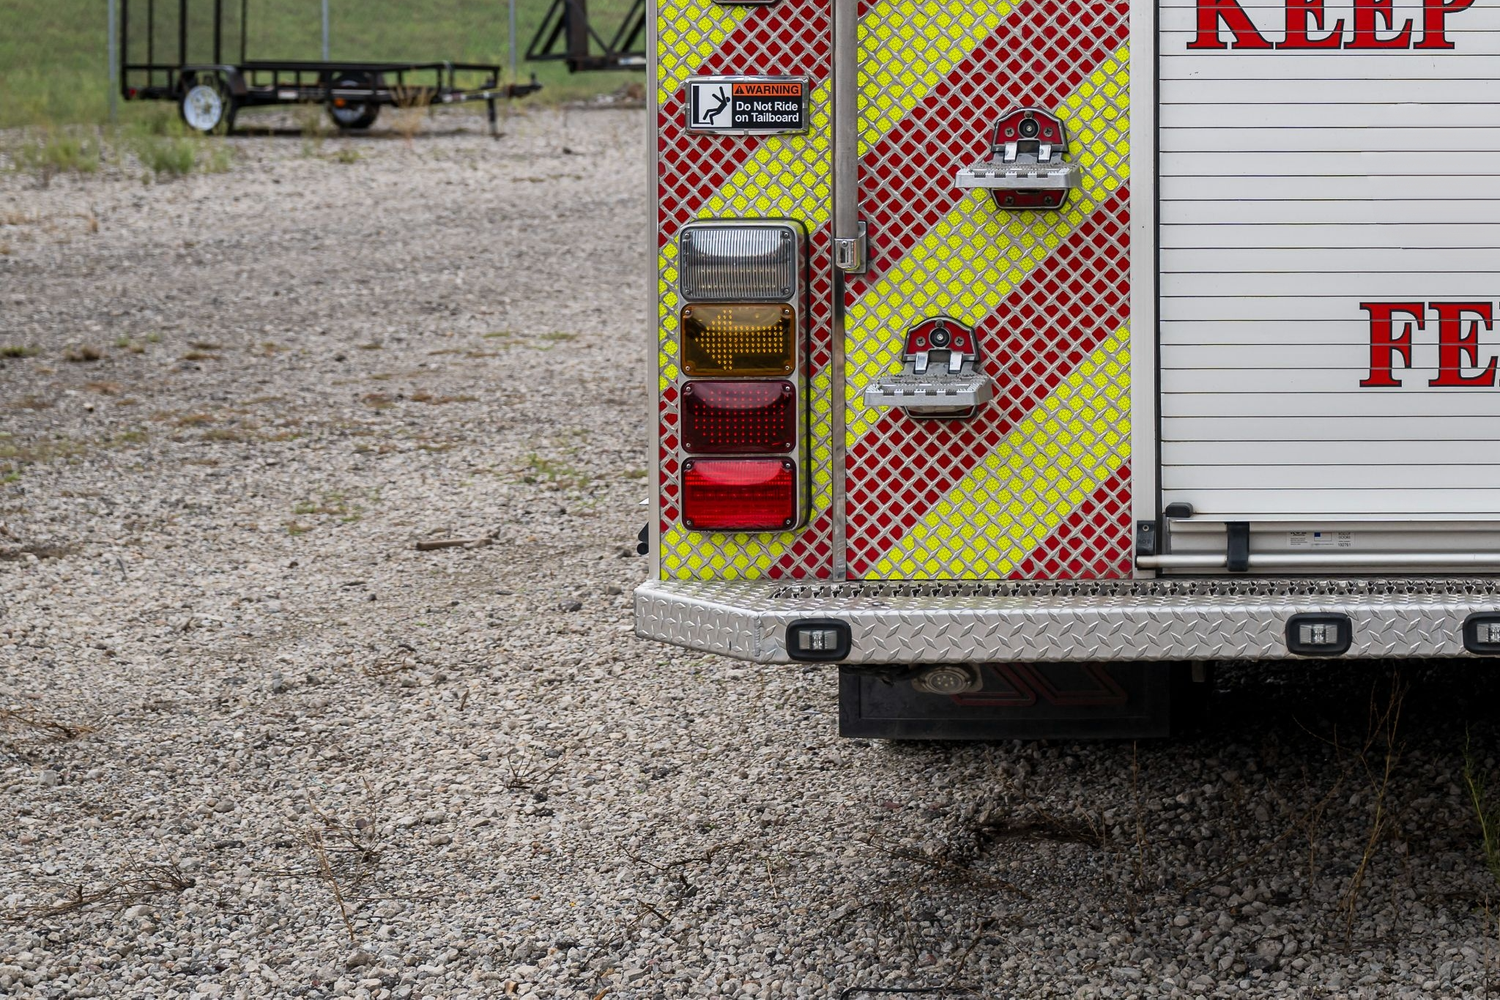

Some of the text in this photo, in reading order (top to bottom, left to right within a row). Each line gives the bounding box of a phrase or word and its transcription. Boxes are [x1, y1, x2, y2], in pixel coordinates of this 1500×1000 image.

[745, 85, 799, 95] WARNING
[736, 101, 799, 111] Do Not Ride
[735, 112, 799, 122] on Tailboard
